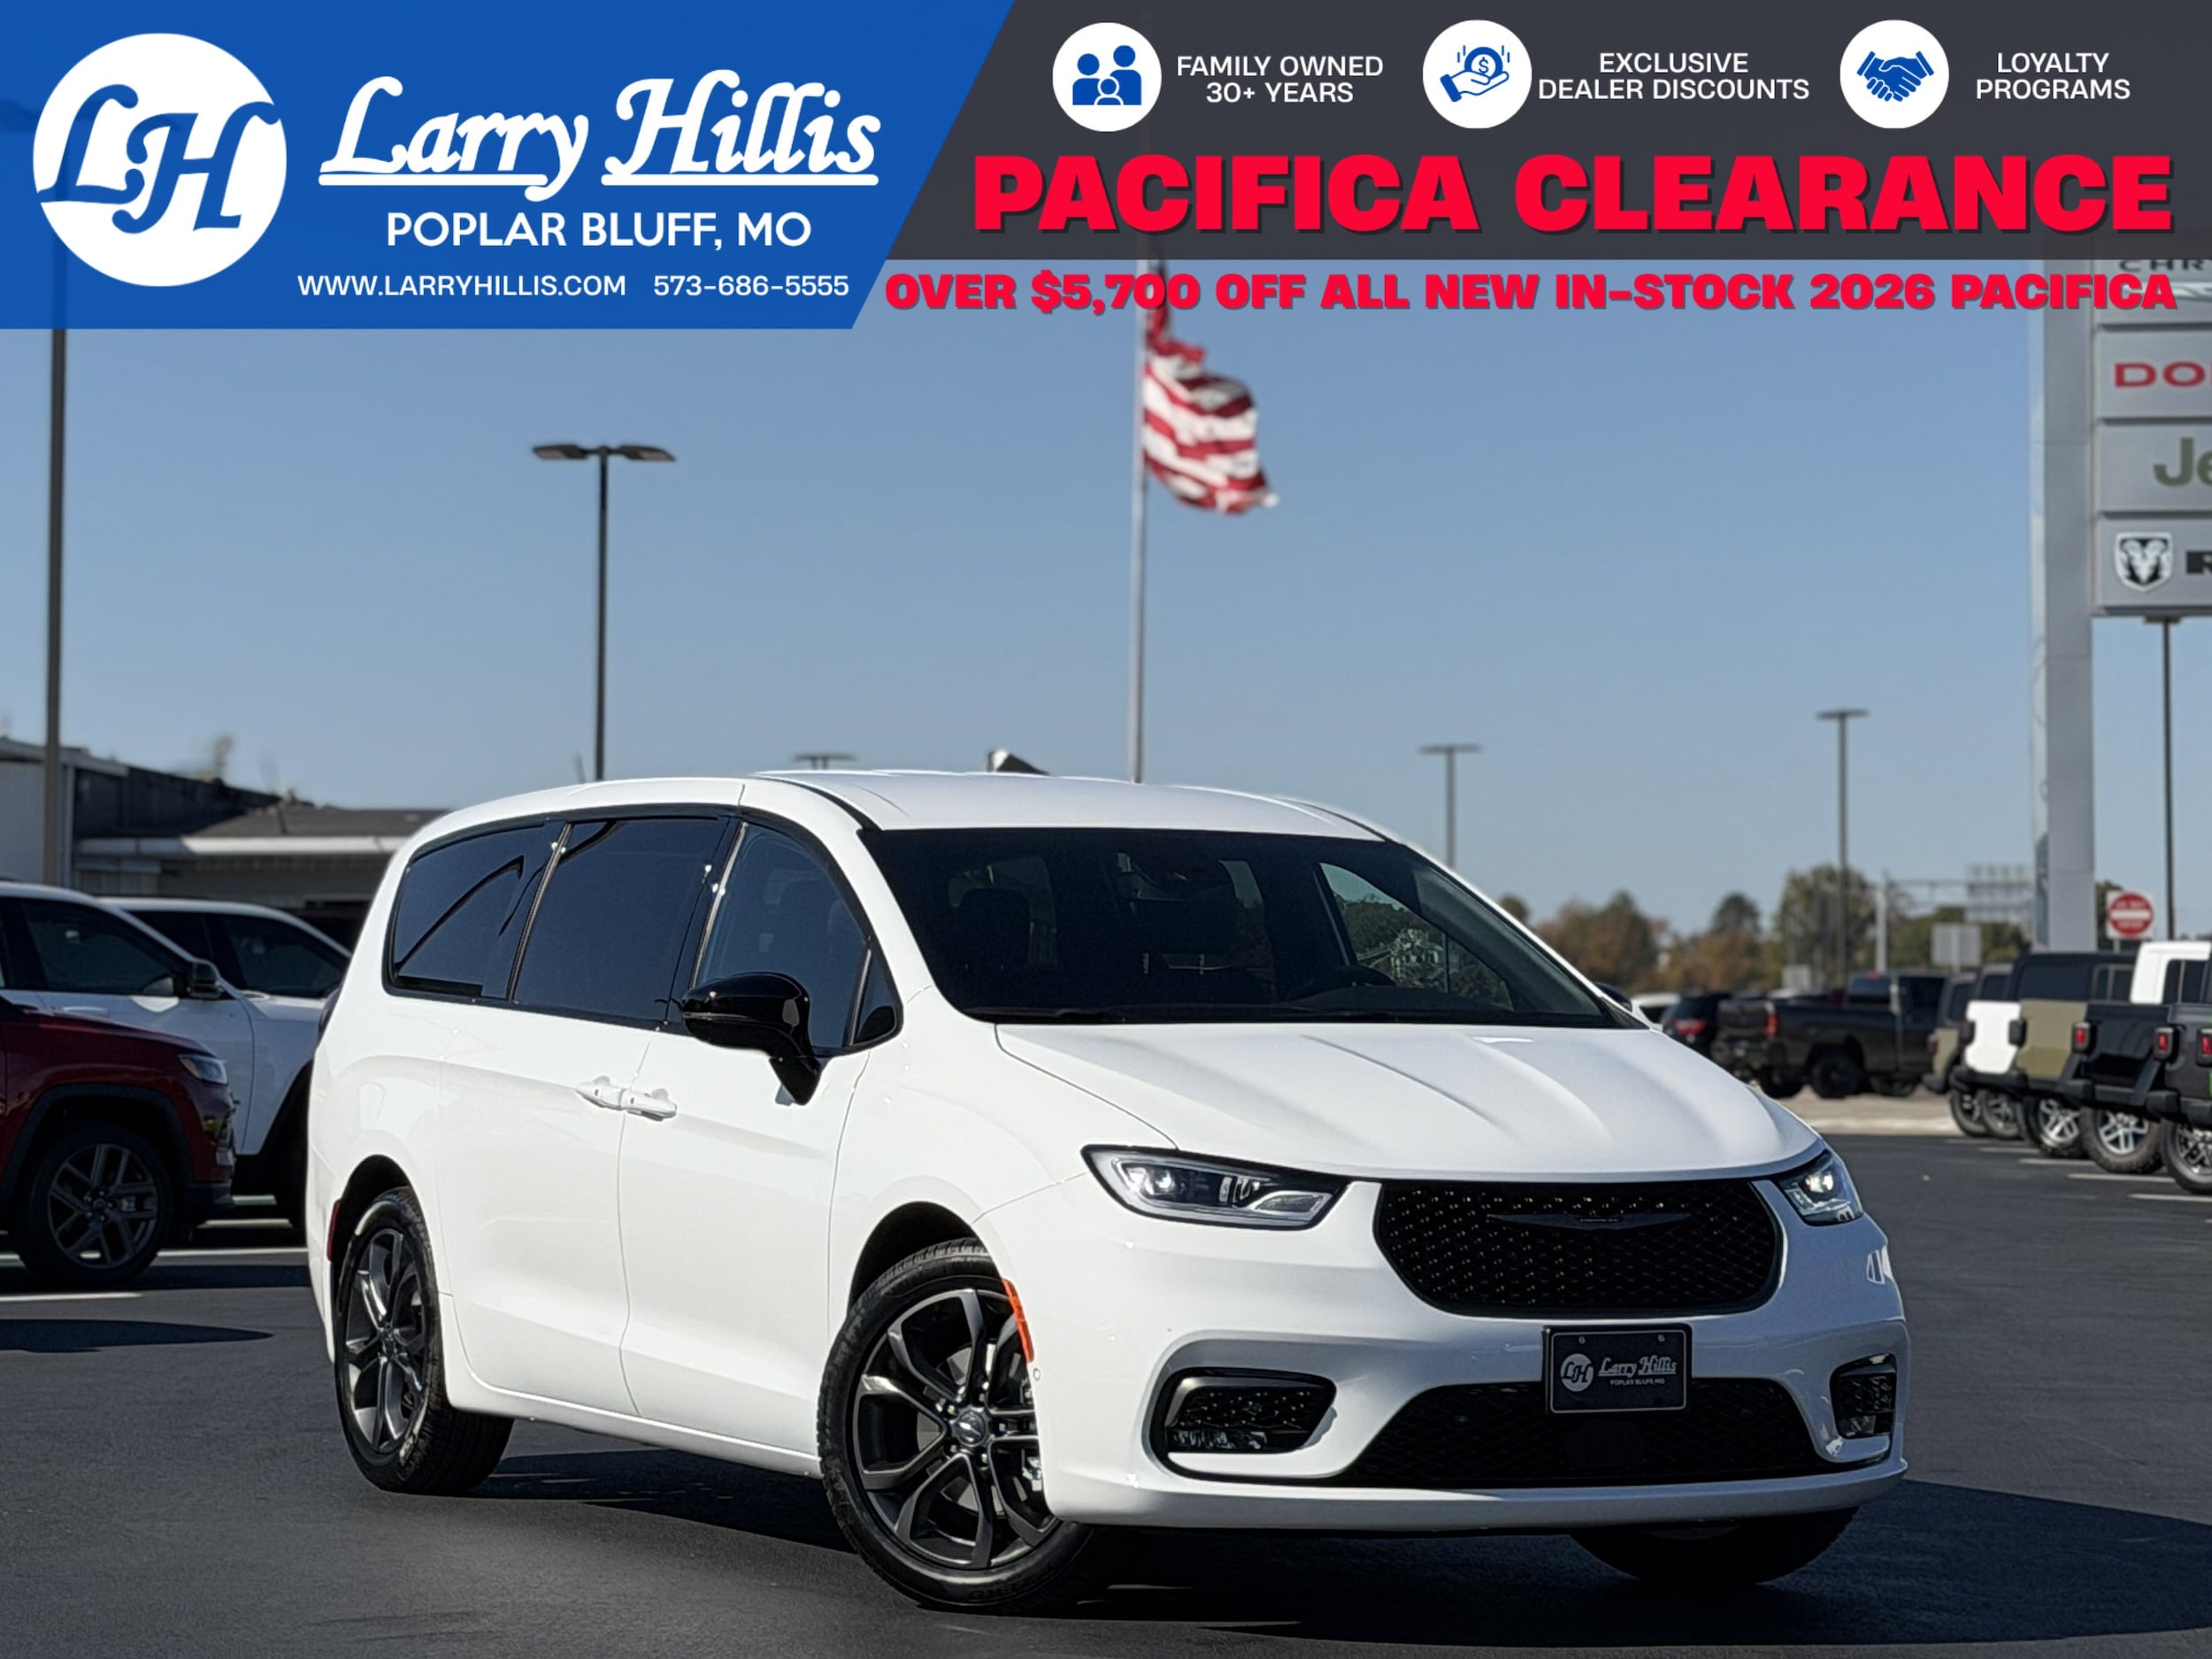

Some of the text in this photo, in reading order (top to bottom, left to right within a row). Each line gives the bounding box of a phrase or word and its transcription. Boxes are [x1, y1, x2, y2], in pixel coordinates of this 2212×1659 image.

[2114, 361, 2212, 388] DO
[1598, 1355, 1678, 1379] Larry Hillis
